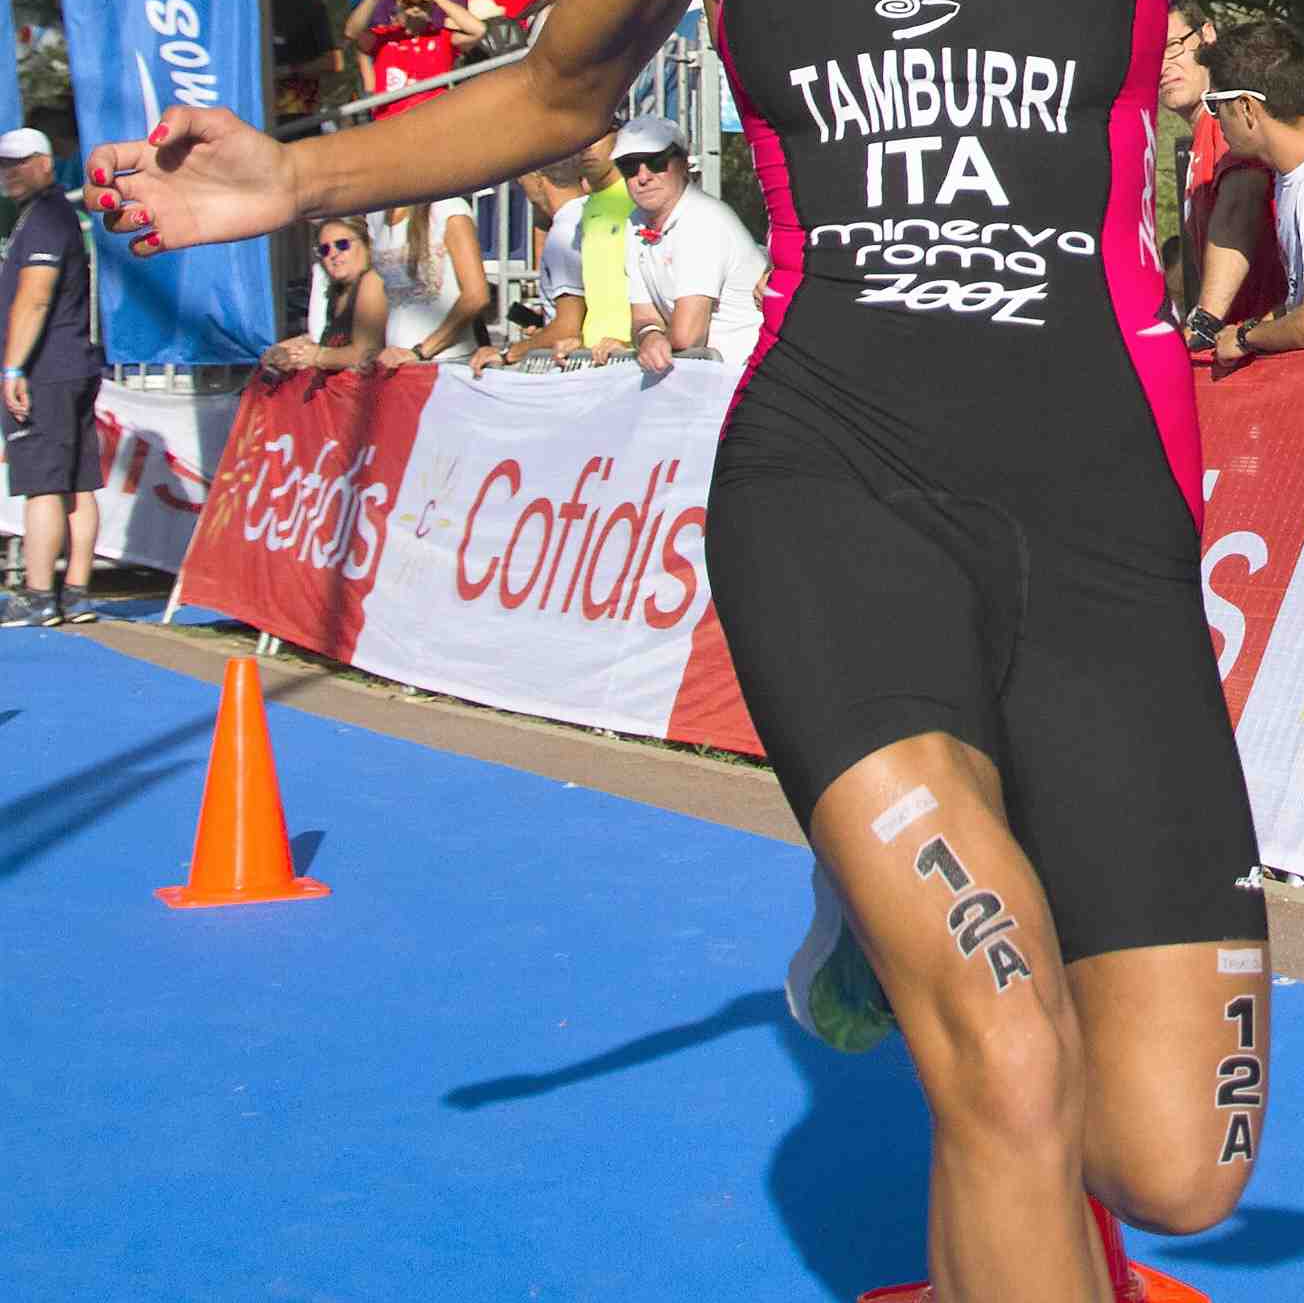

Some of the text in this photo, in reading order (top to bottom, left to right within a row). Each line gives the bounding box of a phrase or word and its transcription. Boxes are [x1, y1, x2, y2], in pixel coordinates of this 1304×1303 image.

[790, 47, 1077, 144] TAMBURRI
[866, 135, 1010, 207] ITA
[811, 218, 1096, 256] minerva
[856, 242, 1046, 275] roma
[457, 457, 706, 630] Cofidis
[1215, 993, 1263, 1166] 12A
